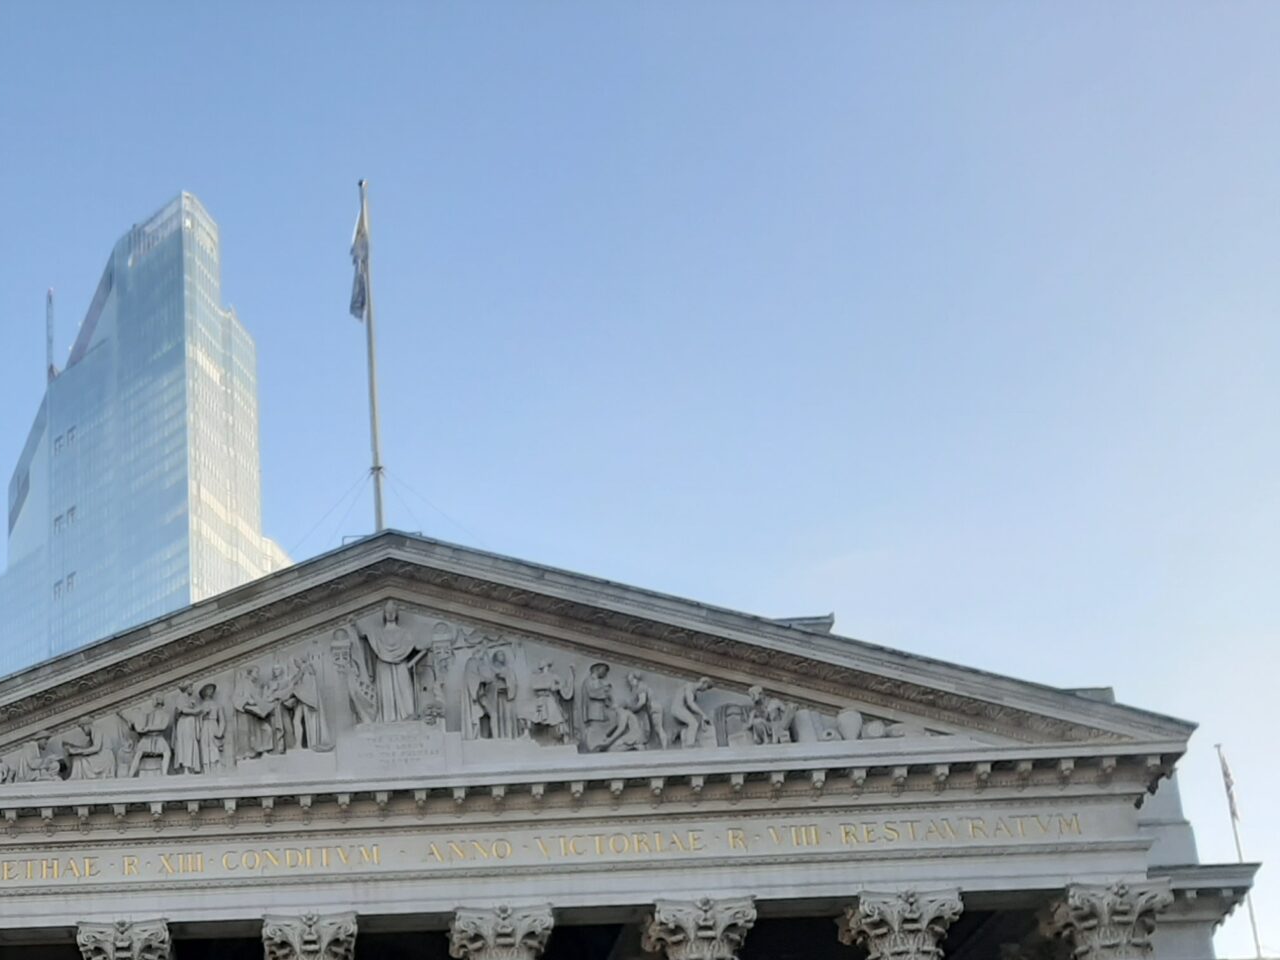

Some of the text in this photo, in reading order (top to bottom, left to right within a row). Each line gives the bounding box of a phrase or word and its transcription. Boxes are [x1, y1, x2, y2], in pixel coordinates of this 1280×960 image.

[122, 855, 140, 876] R
[222, 843, 382, 870] CONDITVM
[420, 838, 513, 862] ANNO
[533, 829, 707, 858] VICTORIAE
[727, 827, 747, 850] R
[767, 823, 820, 847] VIII
[839, 813, 1083, 846] RESTAVRATVM
